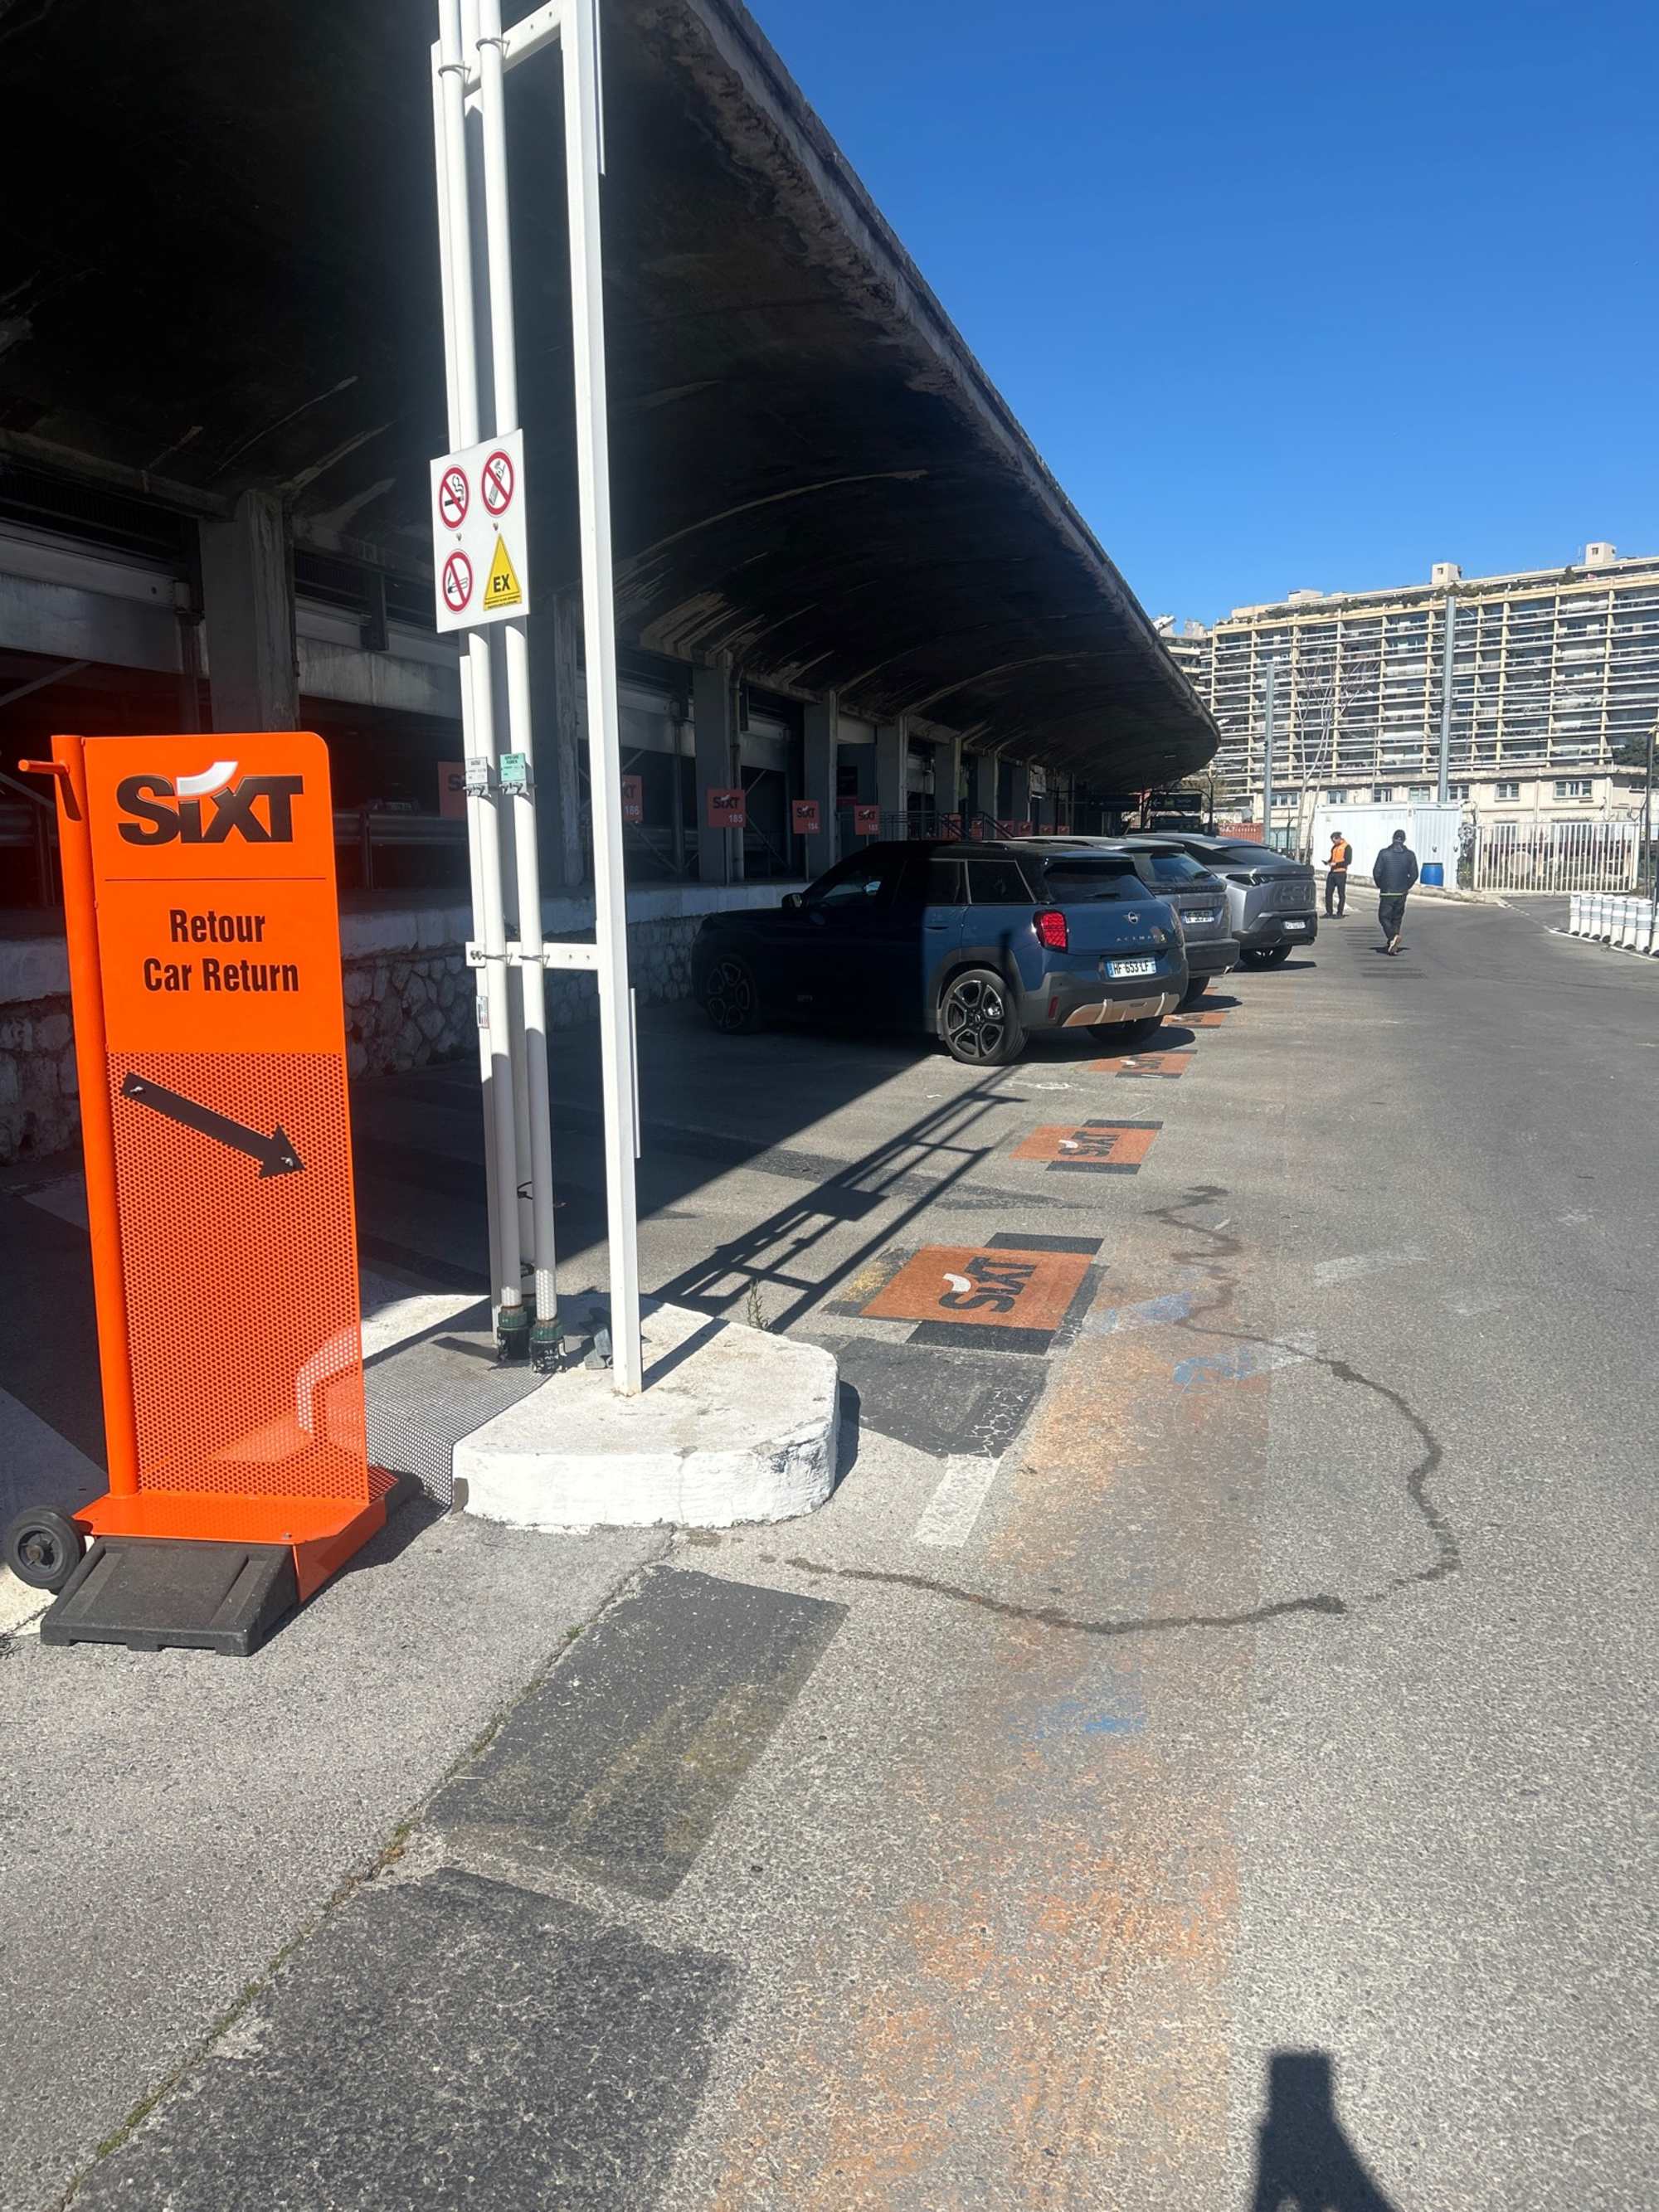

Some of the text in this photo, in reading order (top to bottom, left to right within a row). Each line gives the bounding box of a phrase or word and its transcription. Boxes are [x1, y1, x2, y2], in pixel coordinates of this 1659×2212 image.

[493, 574, 511, 593] EX
[728, 813, 744, 824] 185
[169, 909, 265, 943] Retour
[143, 956, 300, 992] Car Return
